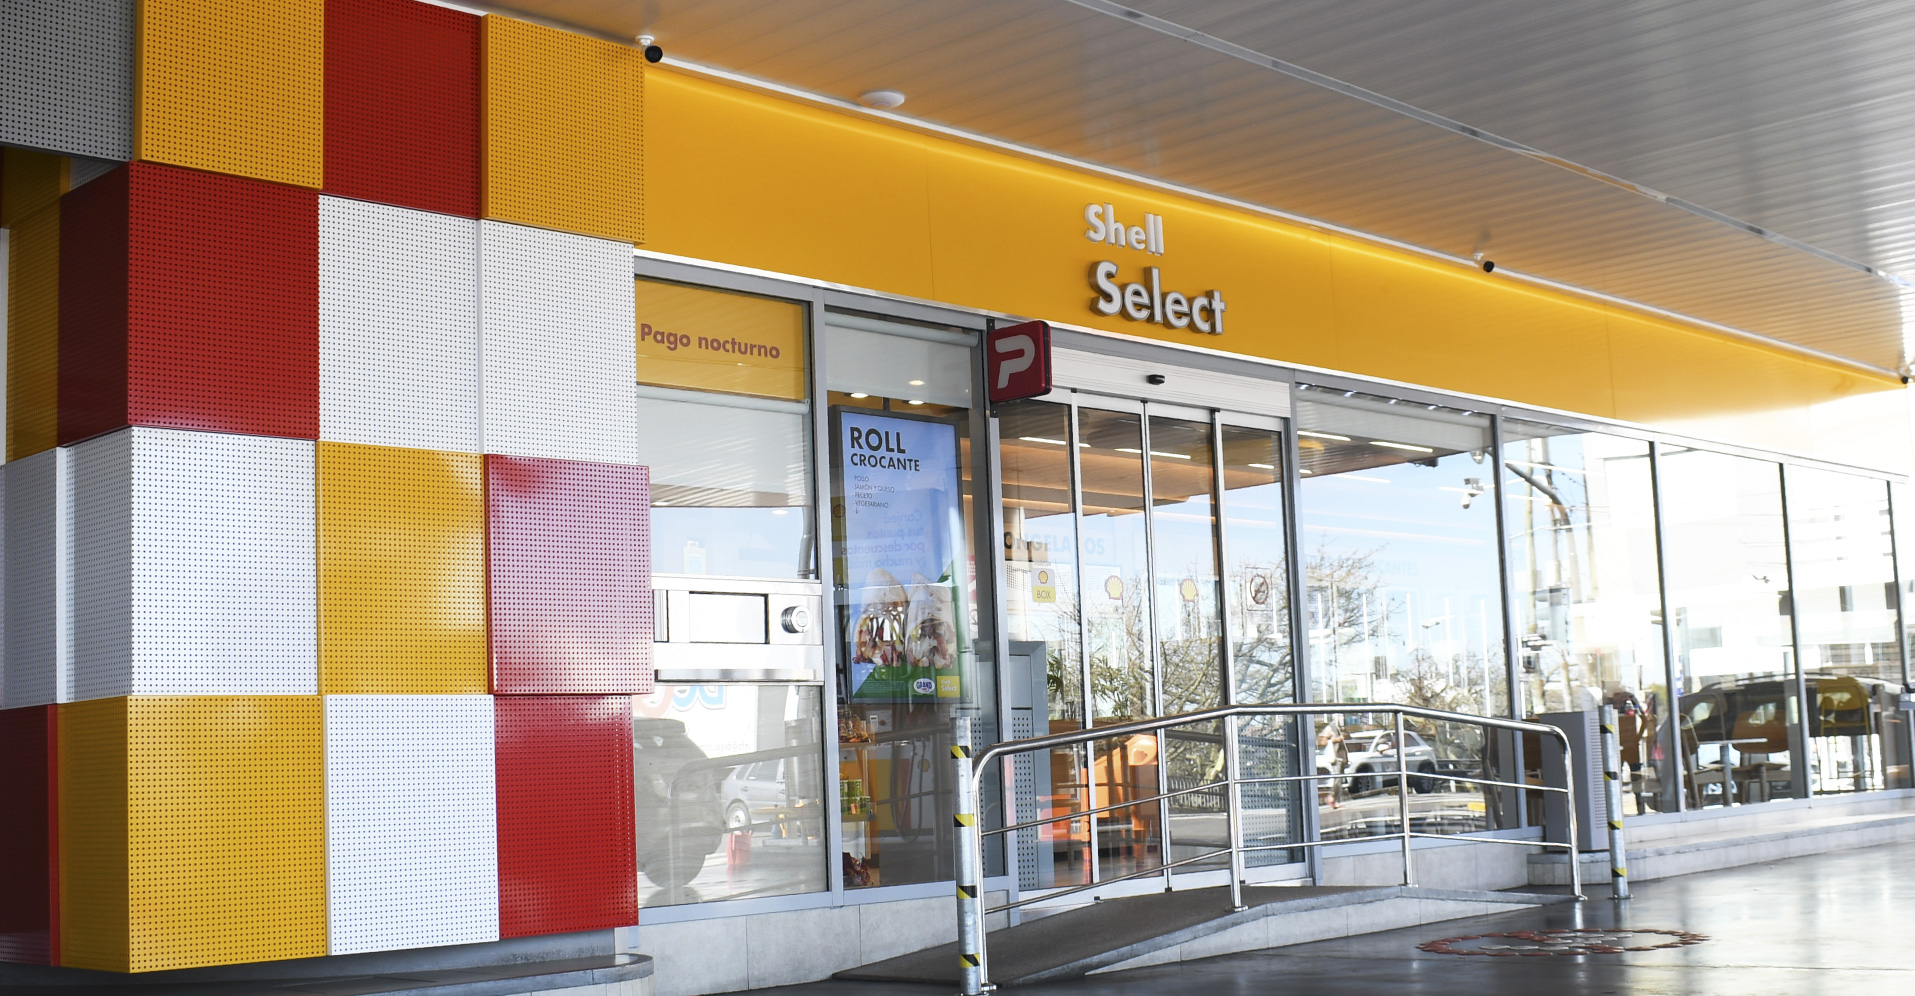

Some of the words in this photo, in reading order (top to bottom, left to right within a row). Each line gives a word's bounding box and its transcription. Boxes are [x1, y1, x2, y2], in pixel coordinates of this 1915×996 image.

[1084, 203, 1165, 256] Shell
[1088, 260, 1227, 335] Select
[640, 323, 691, 351] Pago
[698, 336, 780, 359] nocturno
[850, 427, 906, 454] ROLL
[850, 452, 920, 471] CROCANTE
[1036, 589, 1052, 600] BOX
[916, 681, 933, 690] GRAND
